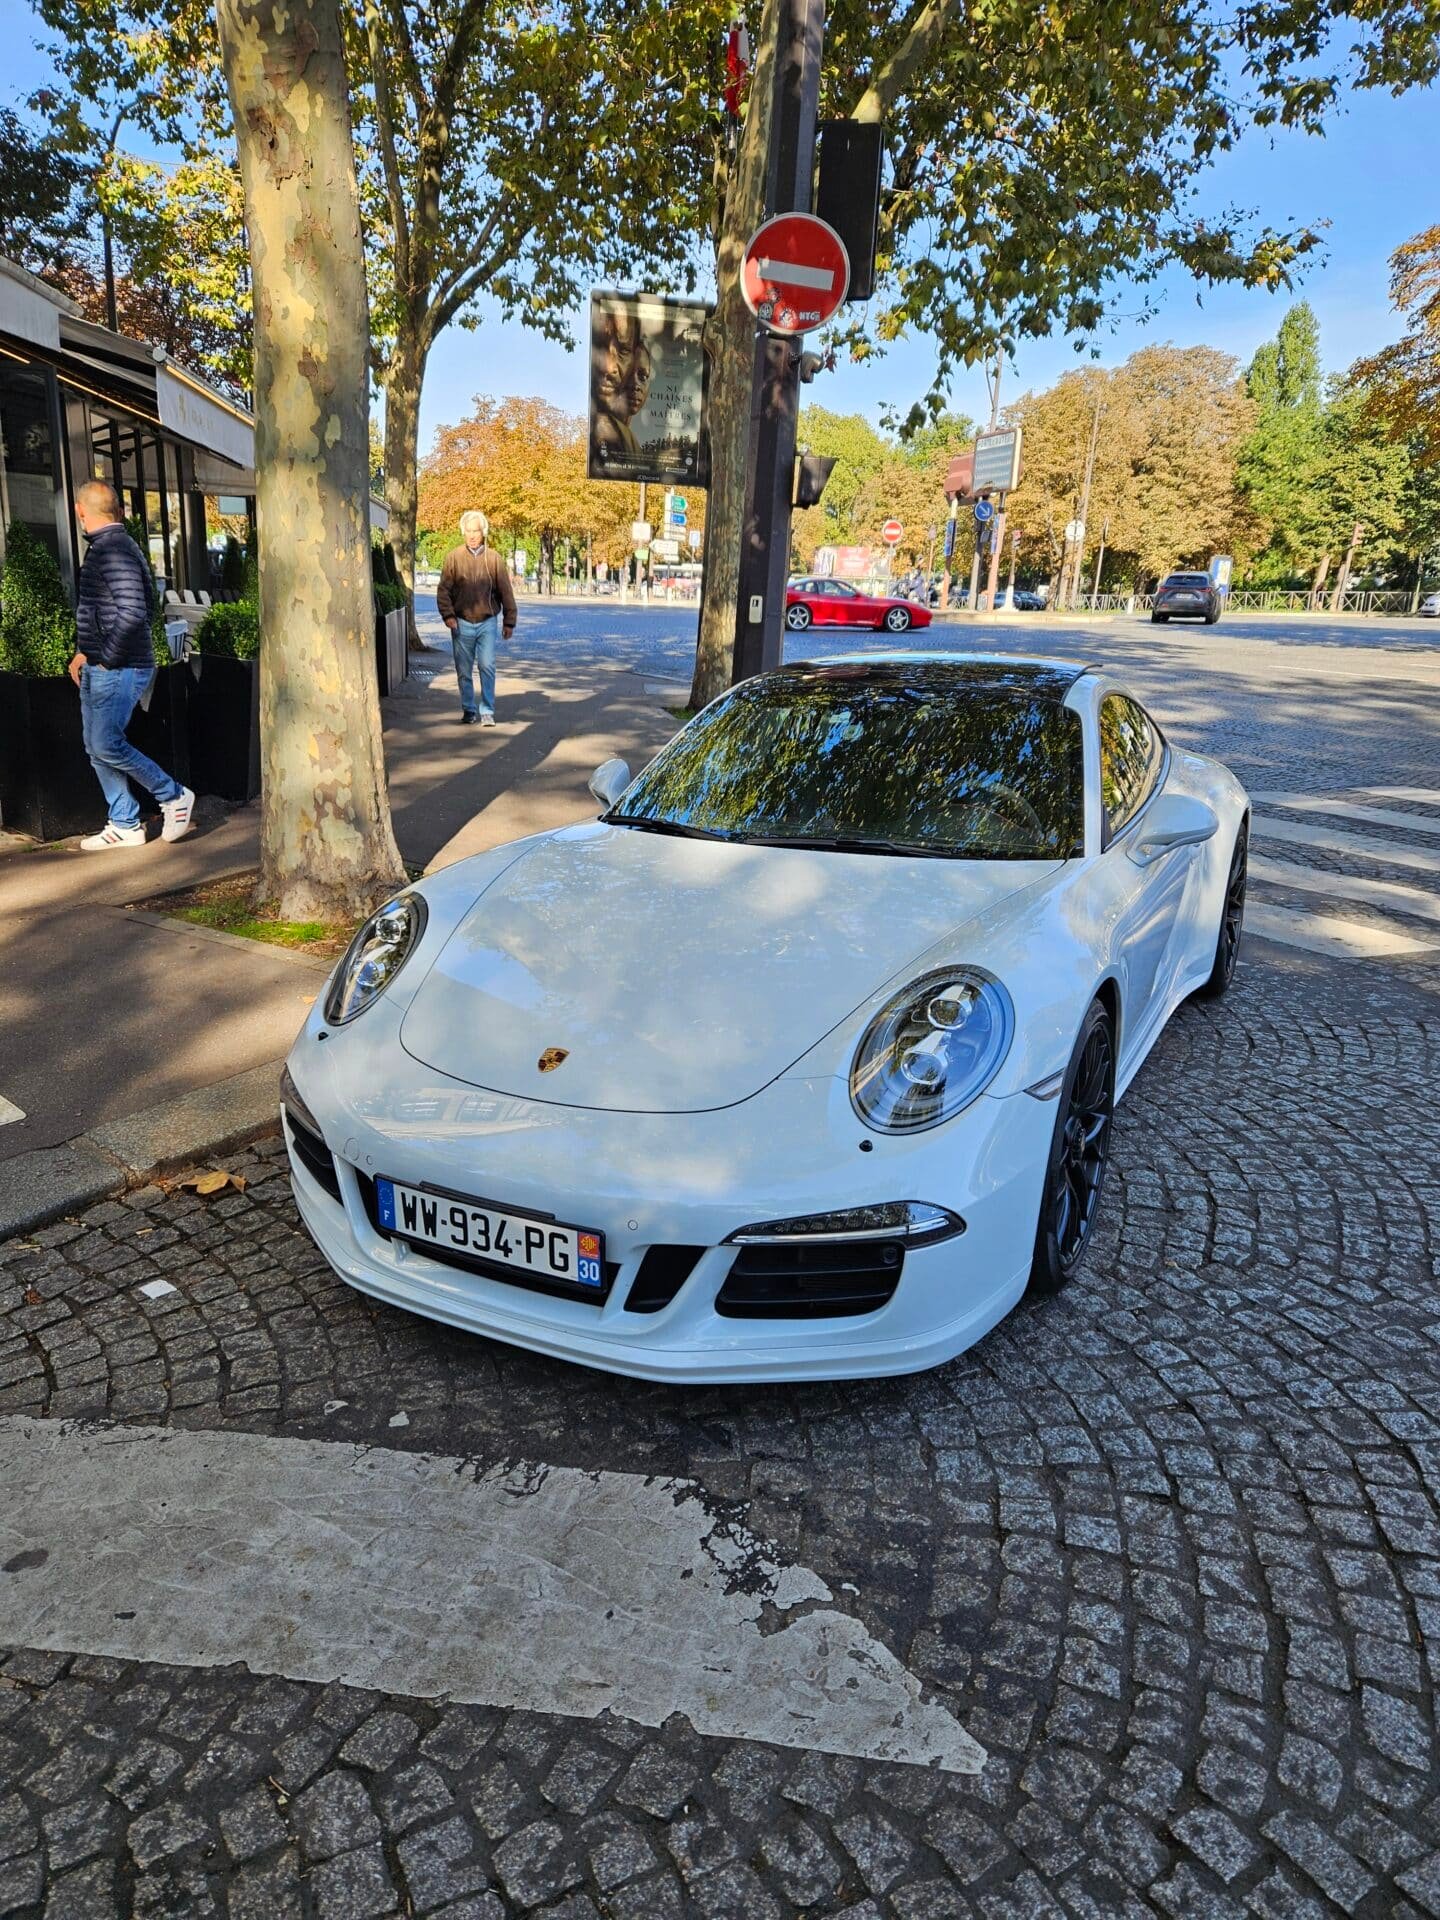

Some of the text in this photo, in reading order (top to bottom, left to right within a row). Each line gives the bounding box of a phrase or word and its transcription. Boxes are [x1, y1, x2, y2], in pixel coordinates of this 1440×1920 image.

[383, 1209, 390, 1221] F
[400, 1192, 569, 1272] WW-934-PG
[579, 1259, 600, 1282] 30
